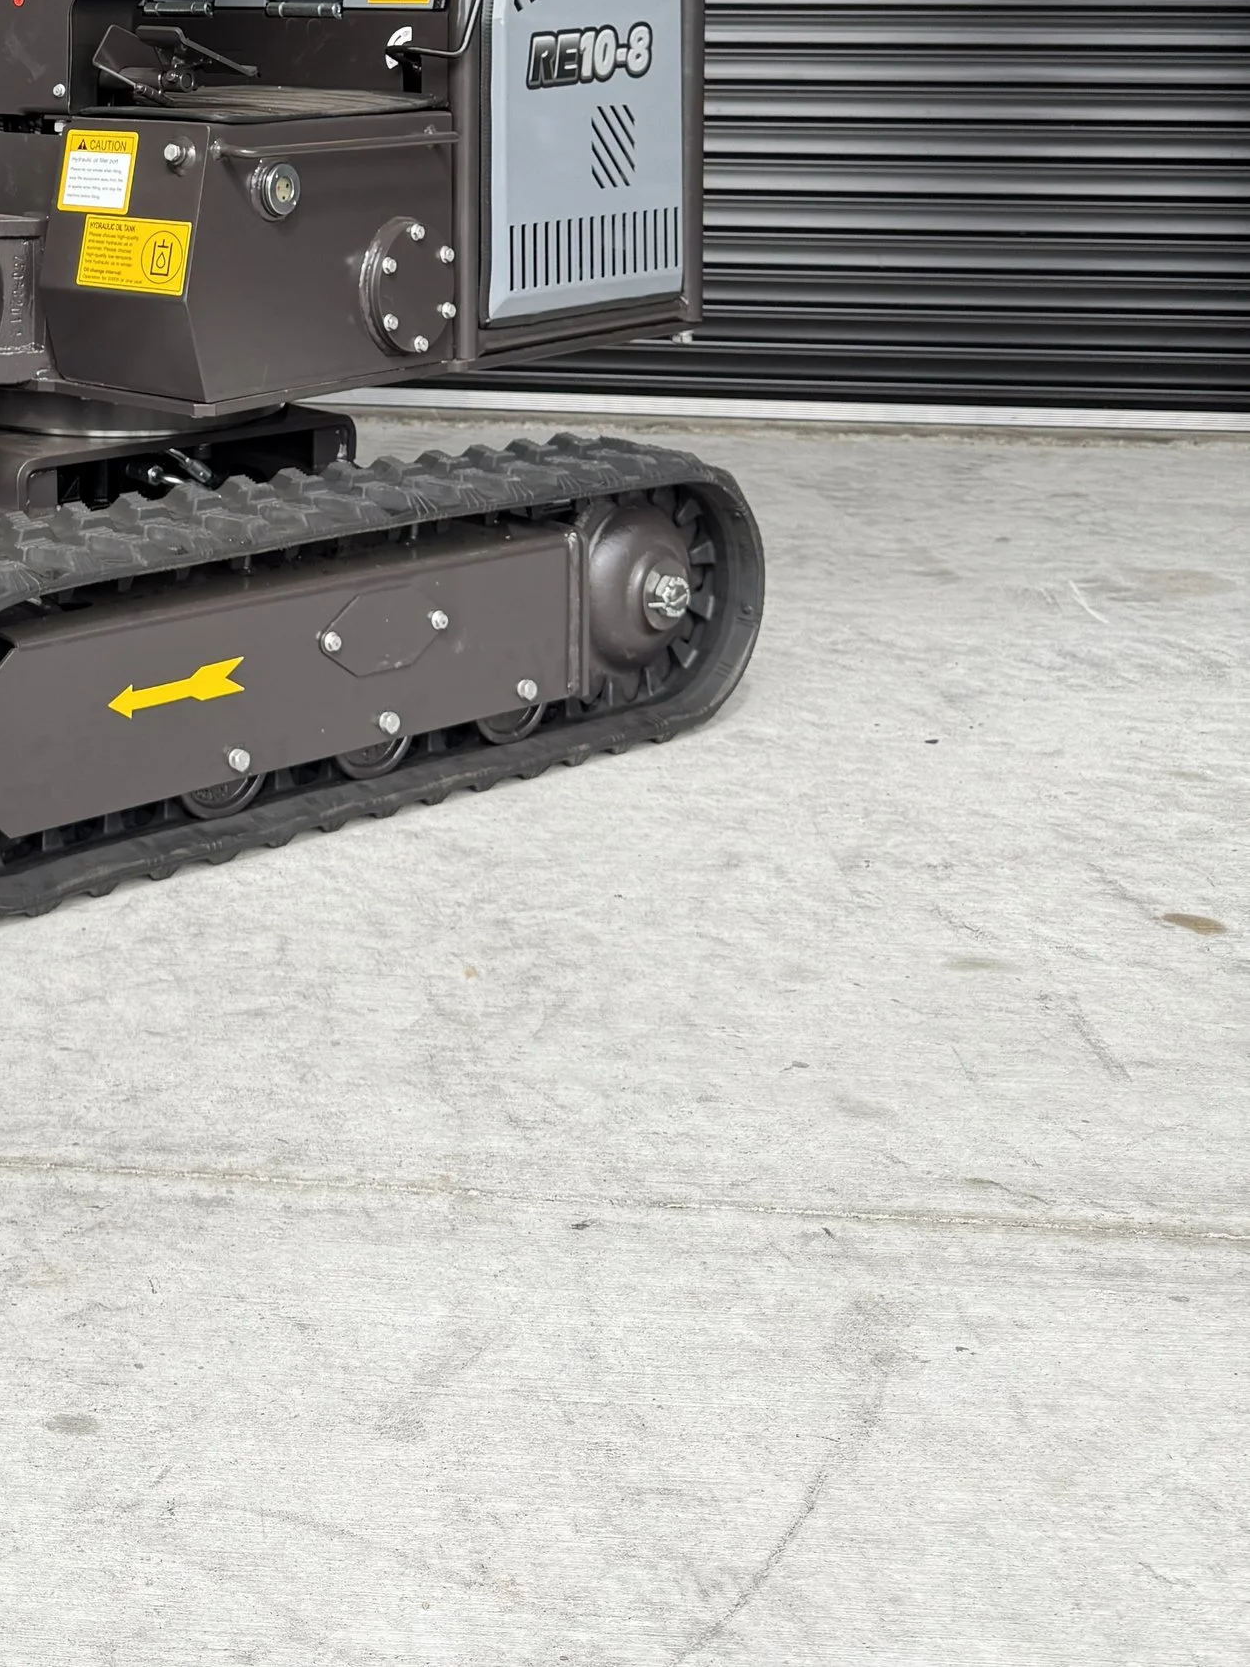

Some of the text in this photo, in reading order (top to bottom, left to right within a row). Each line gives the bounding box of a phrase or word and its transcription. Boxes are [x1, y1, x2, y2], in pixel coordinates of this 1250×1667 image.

[526, 21, 653, 90] RE10-8
[90, 140, 127, 151] CAUTION
[90, 222, 115, 231] HYDRAULIC
[124, 225, 136, 233] TANK
